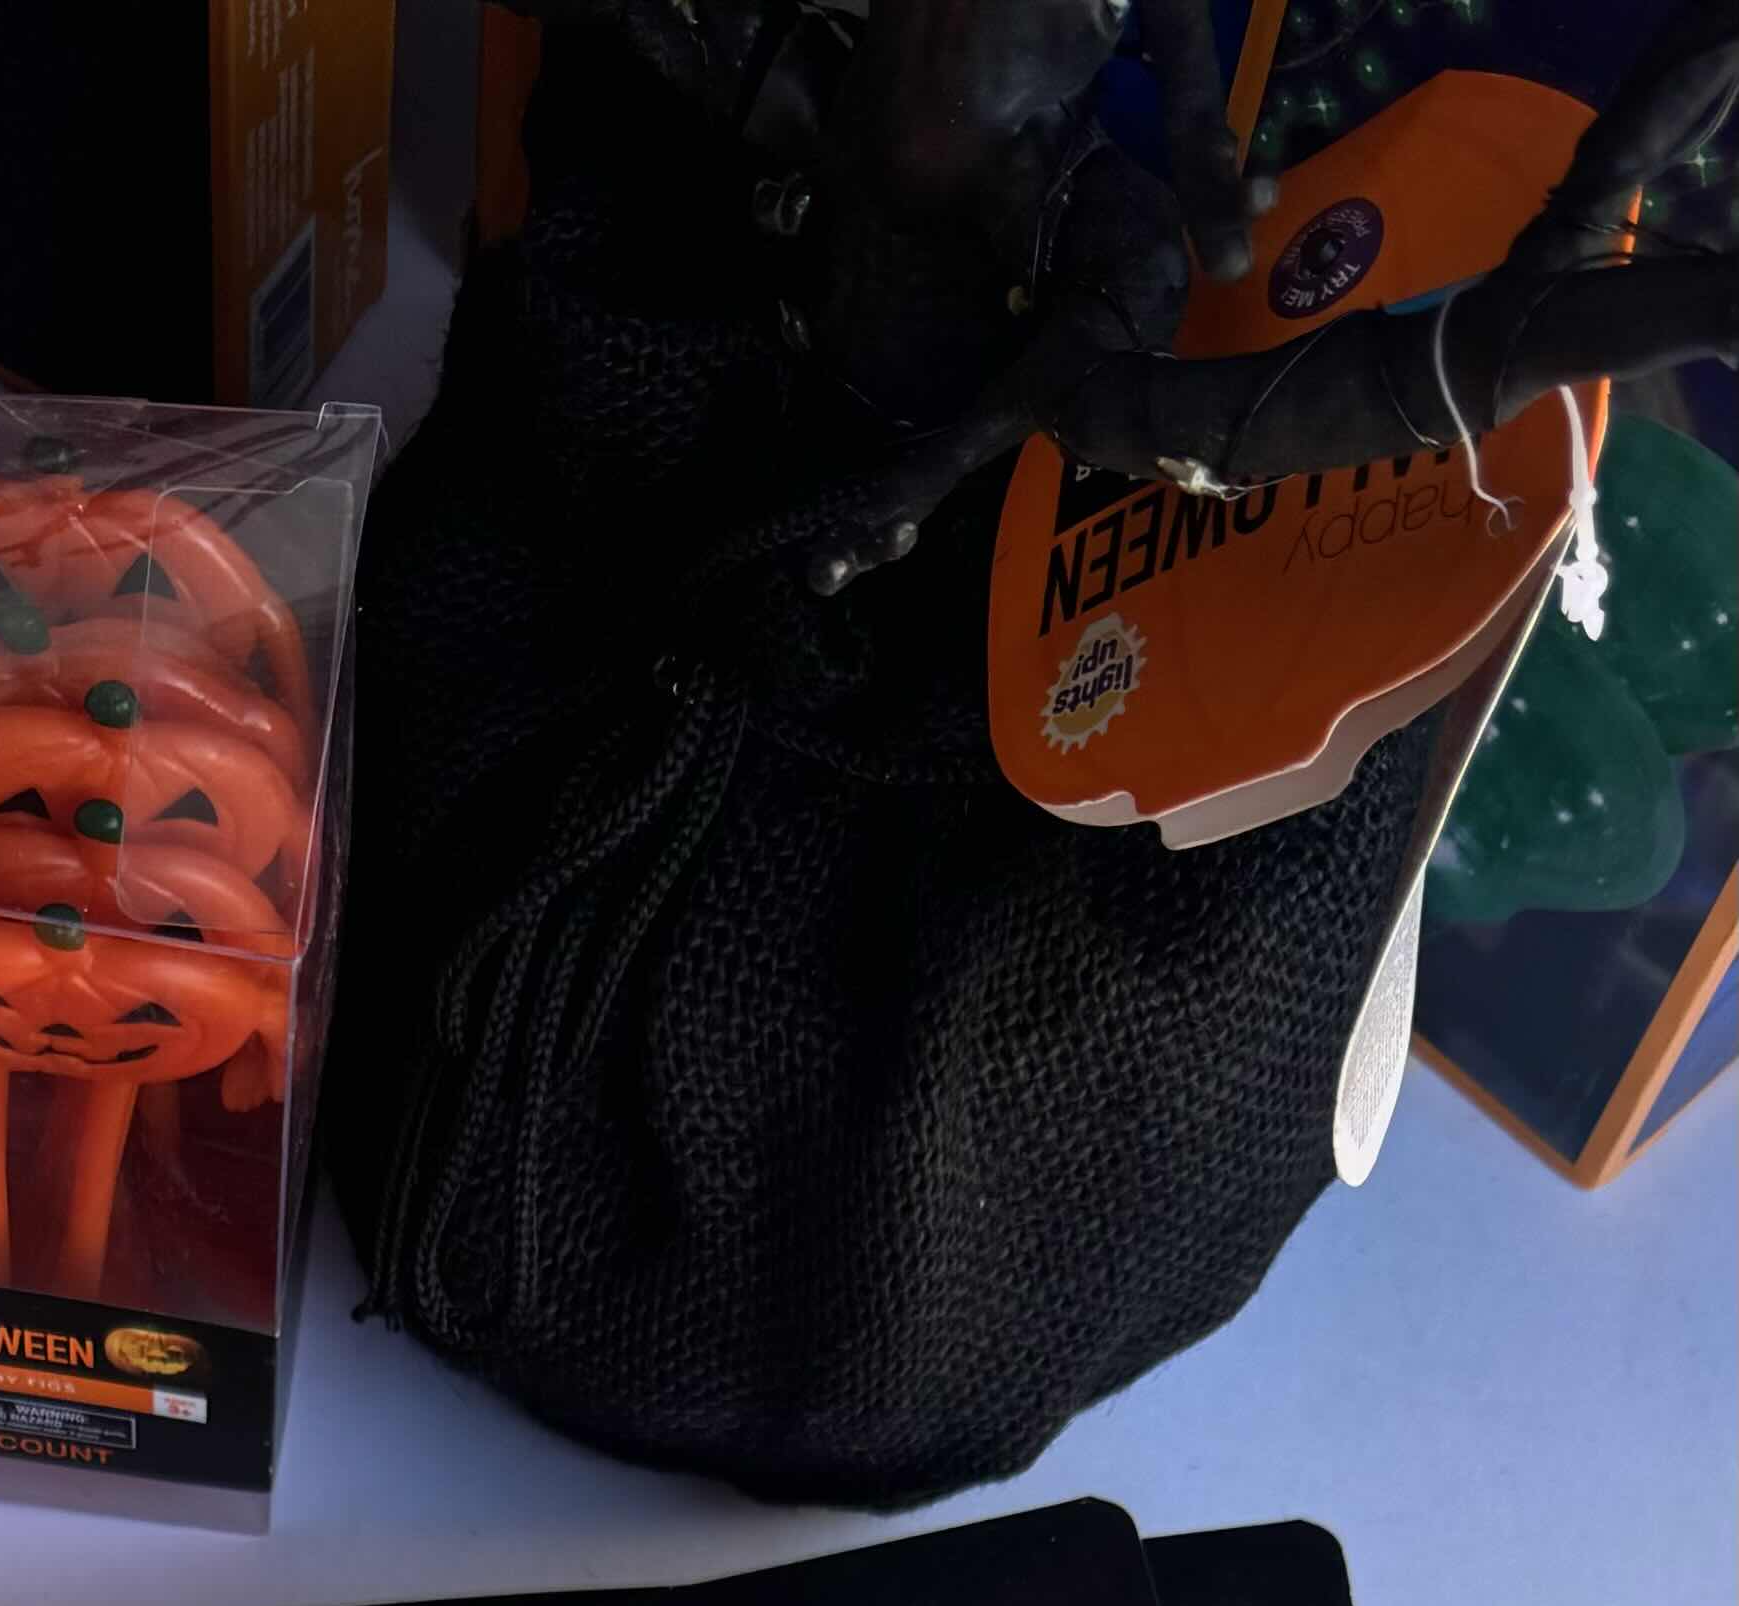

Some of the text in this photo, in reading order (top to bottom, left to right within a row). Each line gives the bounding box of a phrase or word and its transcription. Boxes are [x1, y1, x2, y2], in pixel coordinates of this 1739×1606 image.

[1282, 481, 1476, 575] happy
[1051, 654, 1134, 715] lights
[1073, 638, 1118, 681] up!
